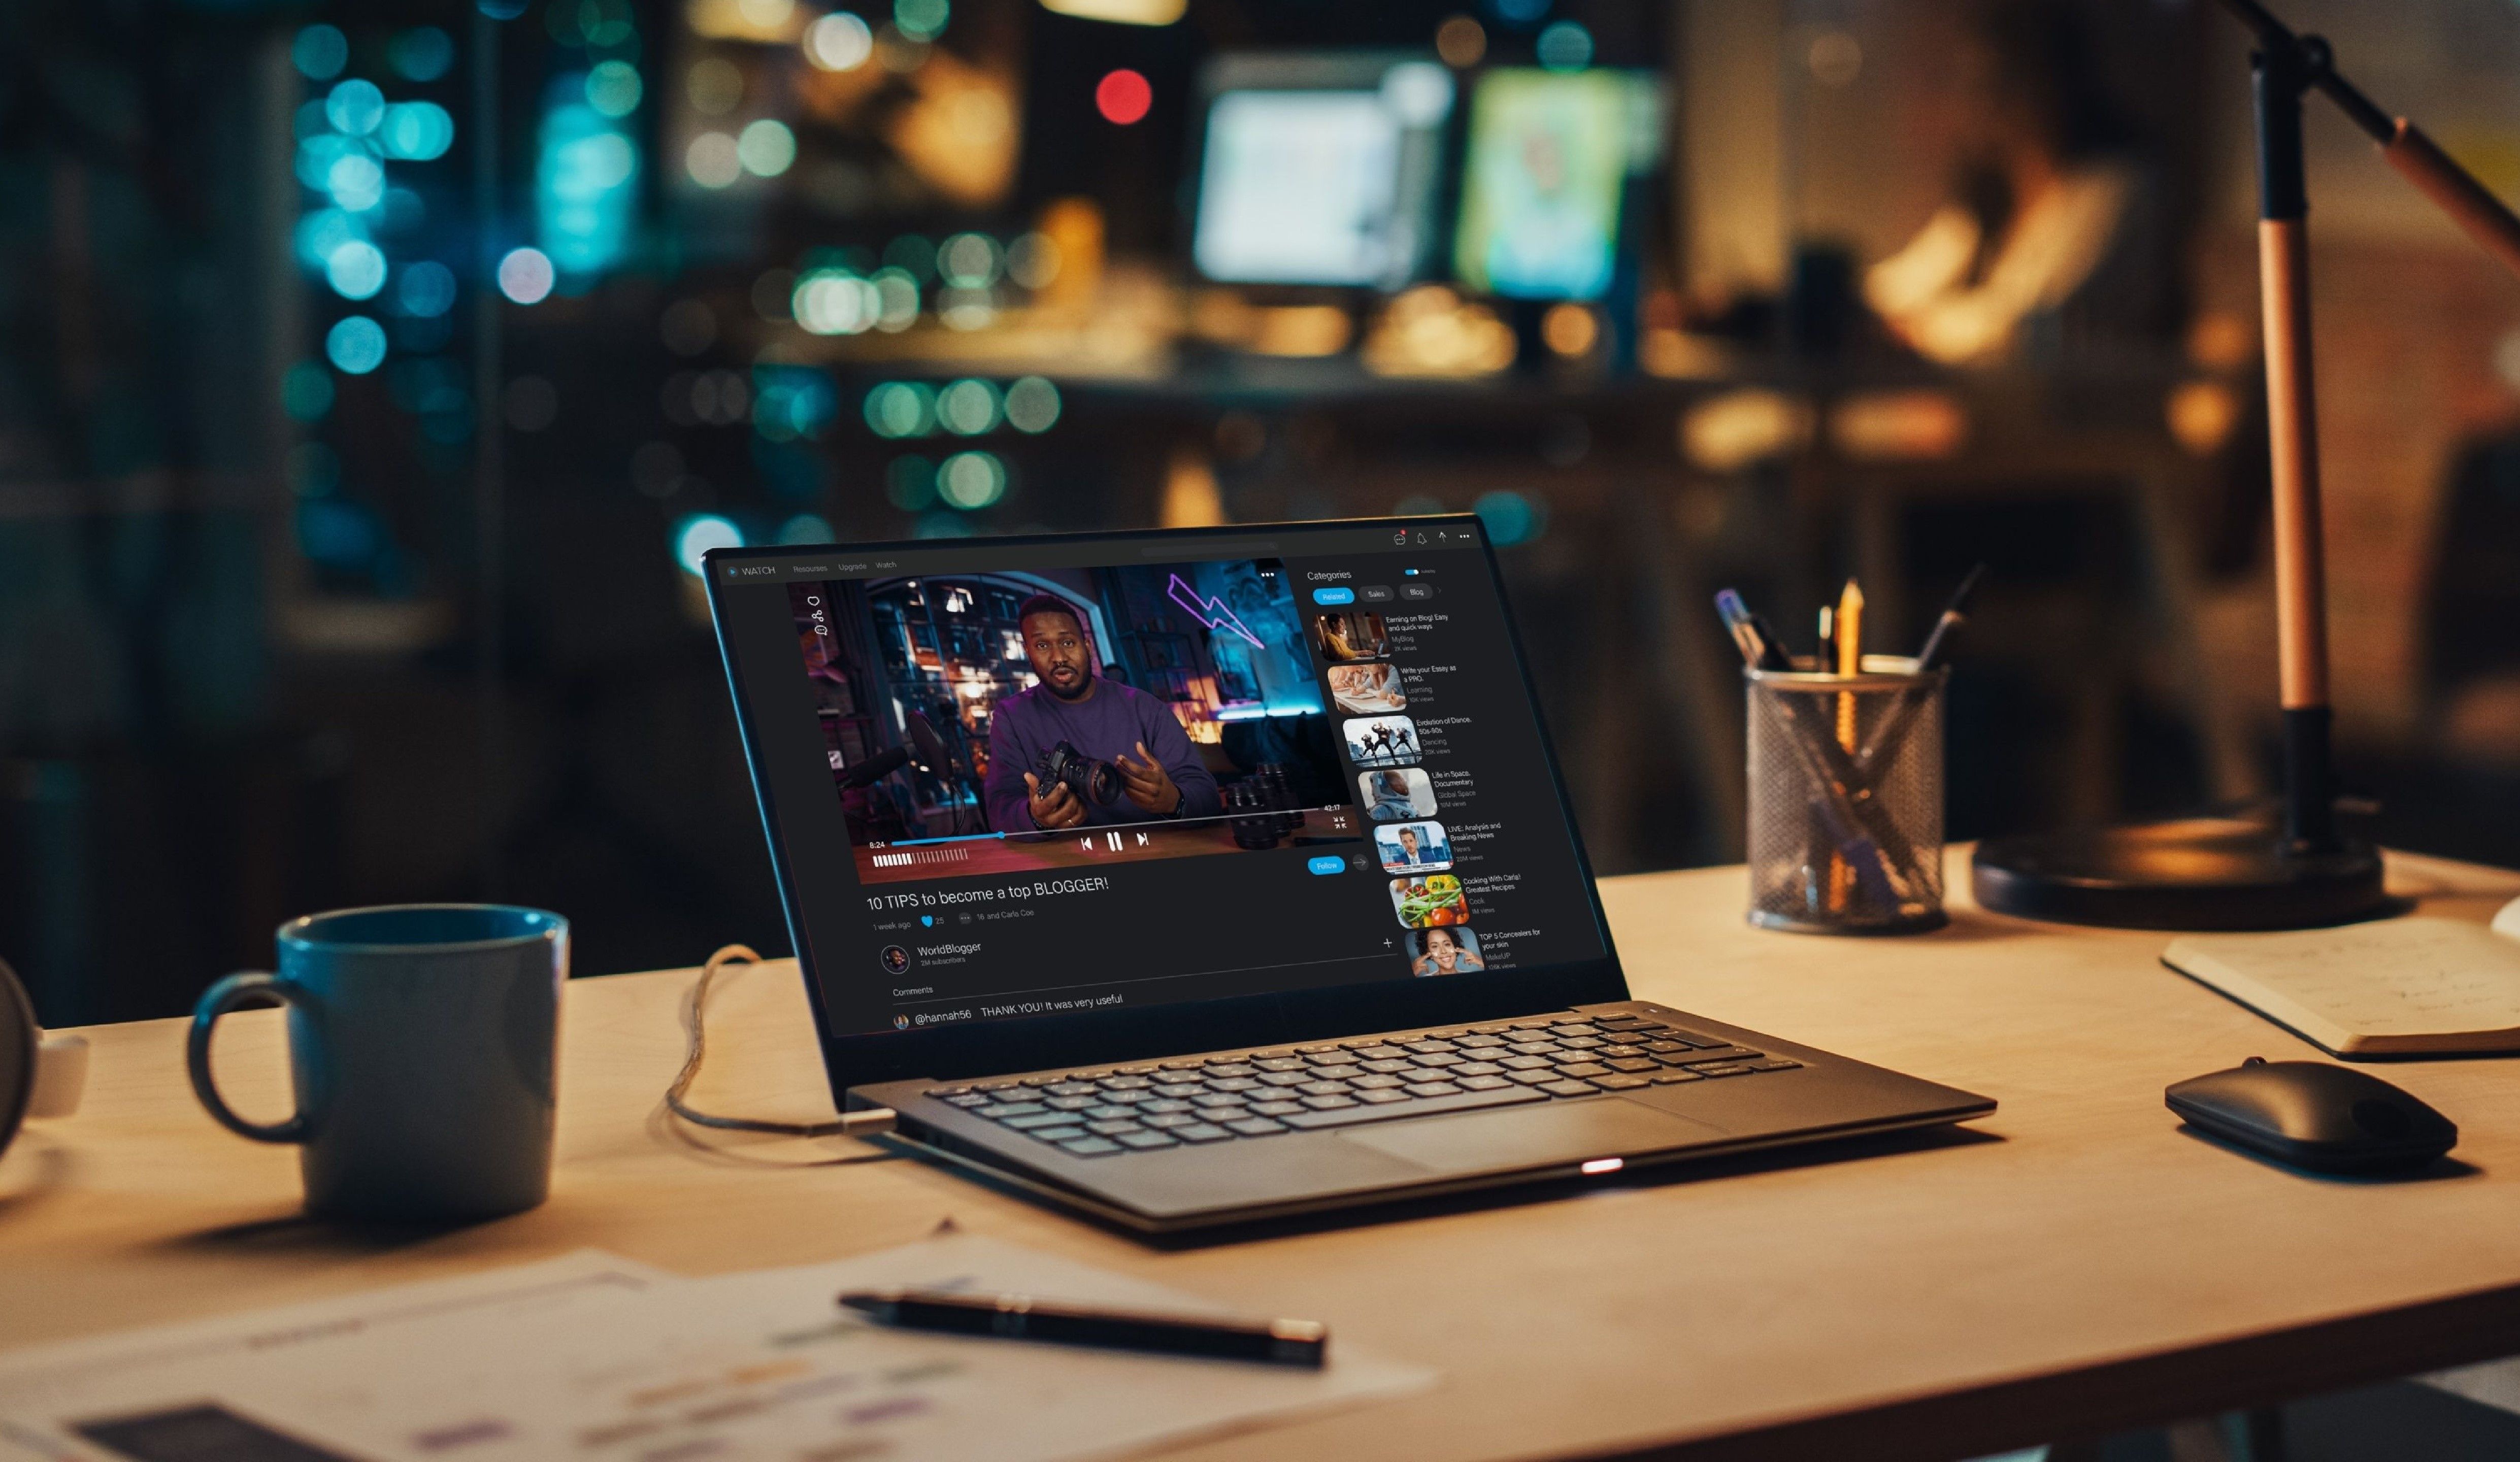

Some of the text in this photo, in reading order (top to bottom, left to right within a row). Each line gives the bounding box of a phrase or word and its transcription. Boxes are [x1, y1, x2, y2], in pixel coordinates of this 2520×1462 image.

[742, 567, 776, 575] WATCH
[838, 562, 867, 572] Upgrade
[1307, 571, 1352, 582] Categories
[1410, 588, 1424, 596] Blog
[1434, 613, 1448, 621] Easy
[1401, 624, 1417, 632] quick
[1391, 636, 1414, 644] MyBlog
[1465, 823, 1489, 832] Analysis
[867, 877, 1109, 911] 10 TIPS to become a top BLOGGER!
[898, 921, 911, 929] ago
[935, 917, 945, 925] 25
[1499, 931, 1532, 939] Concealers
[917, 944, 981, 956] WorldBlogger
[932, 957, 966, 965] subscribers
[893, 986, 934, 996] Comments
[980, 994, 1123, 1017] THANK YOU! It was very useful
[915, 1009, 972, 1025] @hannah56
